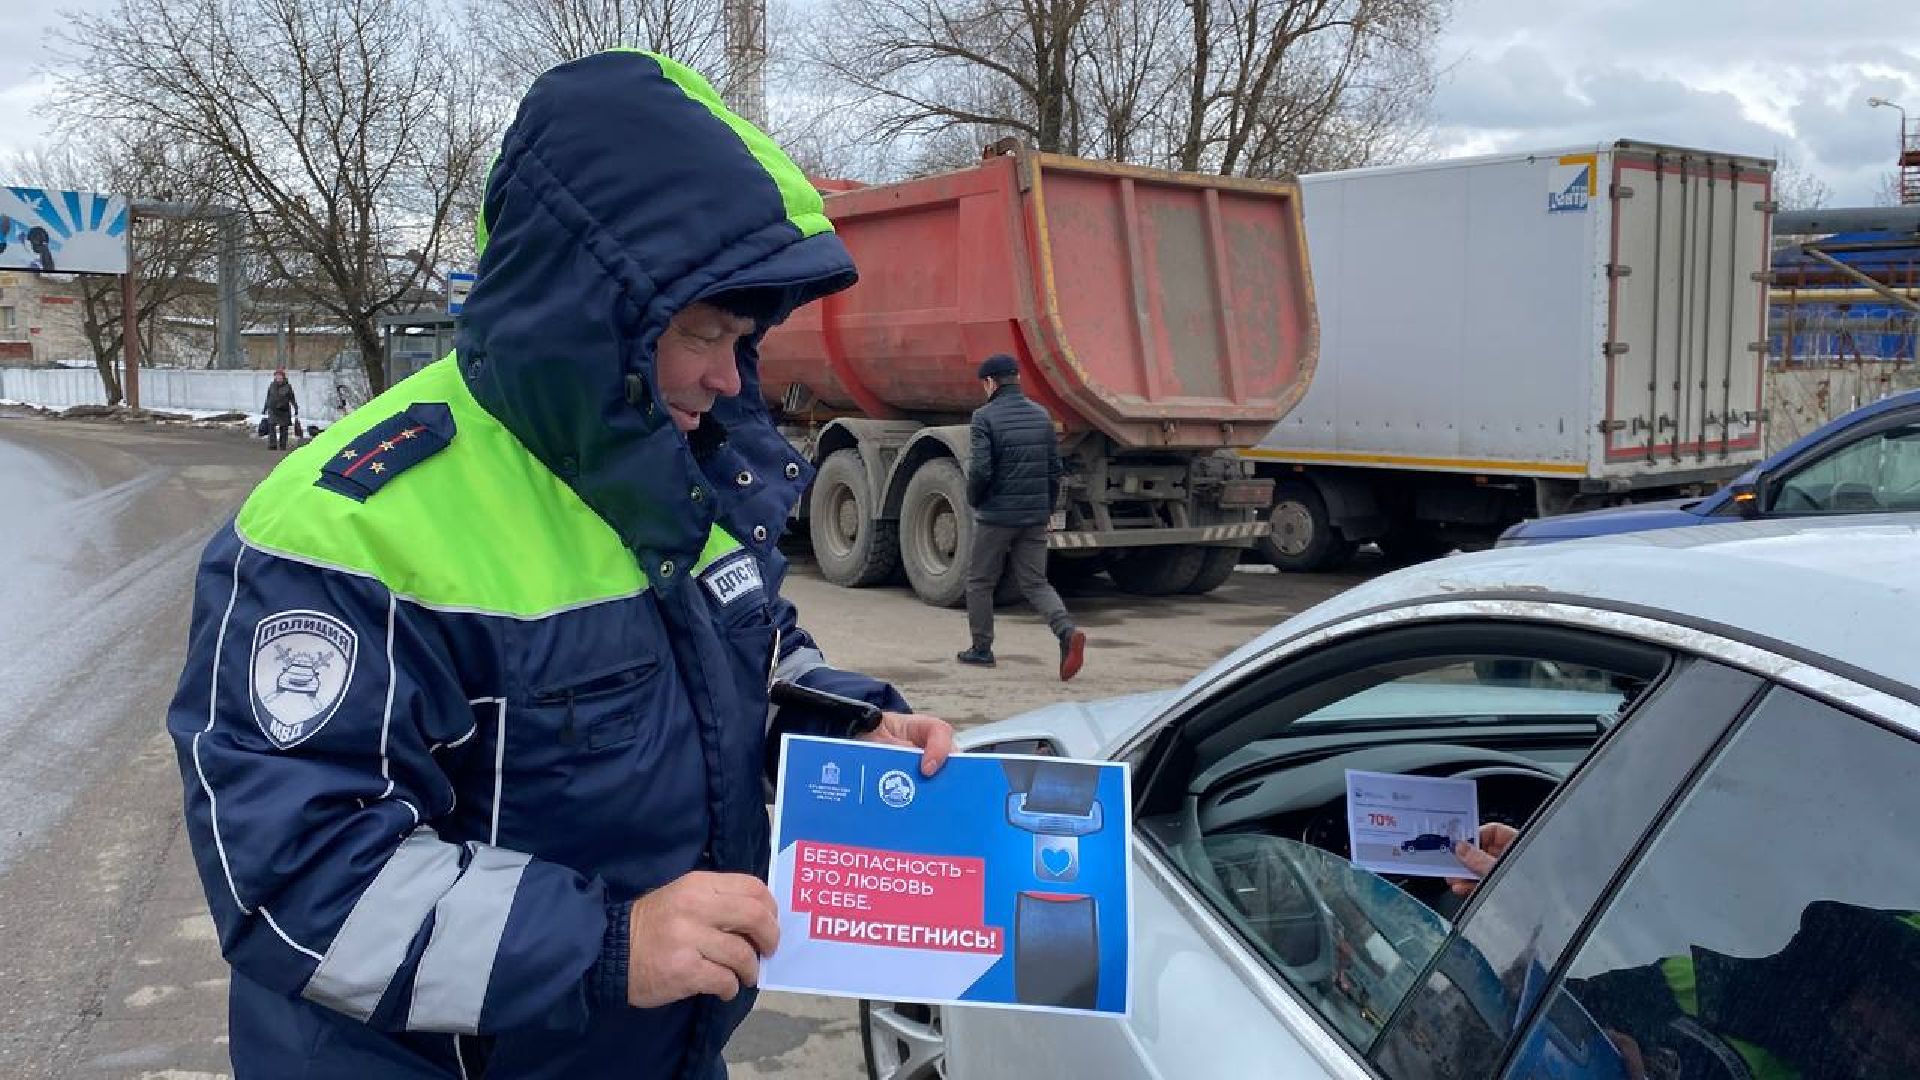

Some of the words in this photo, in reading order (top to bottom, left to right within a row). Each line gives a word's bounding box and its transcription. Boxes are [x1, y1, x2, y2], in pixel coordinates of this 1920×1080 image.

[260, 618, 350, 654] ПОЛИЦИЯ
[269, 717, 304, 742] МВД
[1368, 813, 1397, 827] 70%
[803, 847, 961, 878] БЕЗОПАСНОСТЬ
[801, 867, 840, 885] ЭТО
[845, 873, 933, 896] ЛЮБОВЬ
[800, 888, 812, 903] К
[818, 891, 871, 910] СЕБЕ.
[816, 916, 997, 949] ПРИСТЕГНИСЬ!
